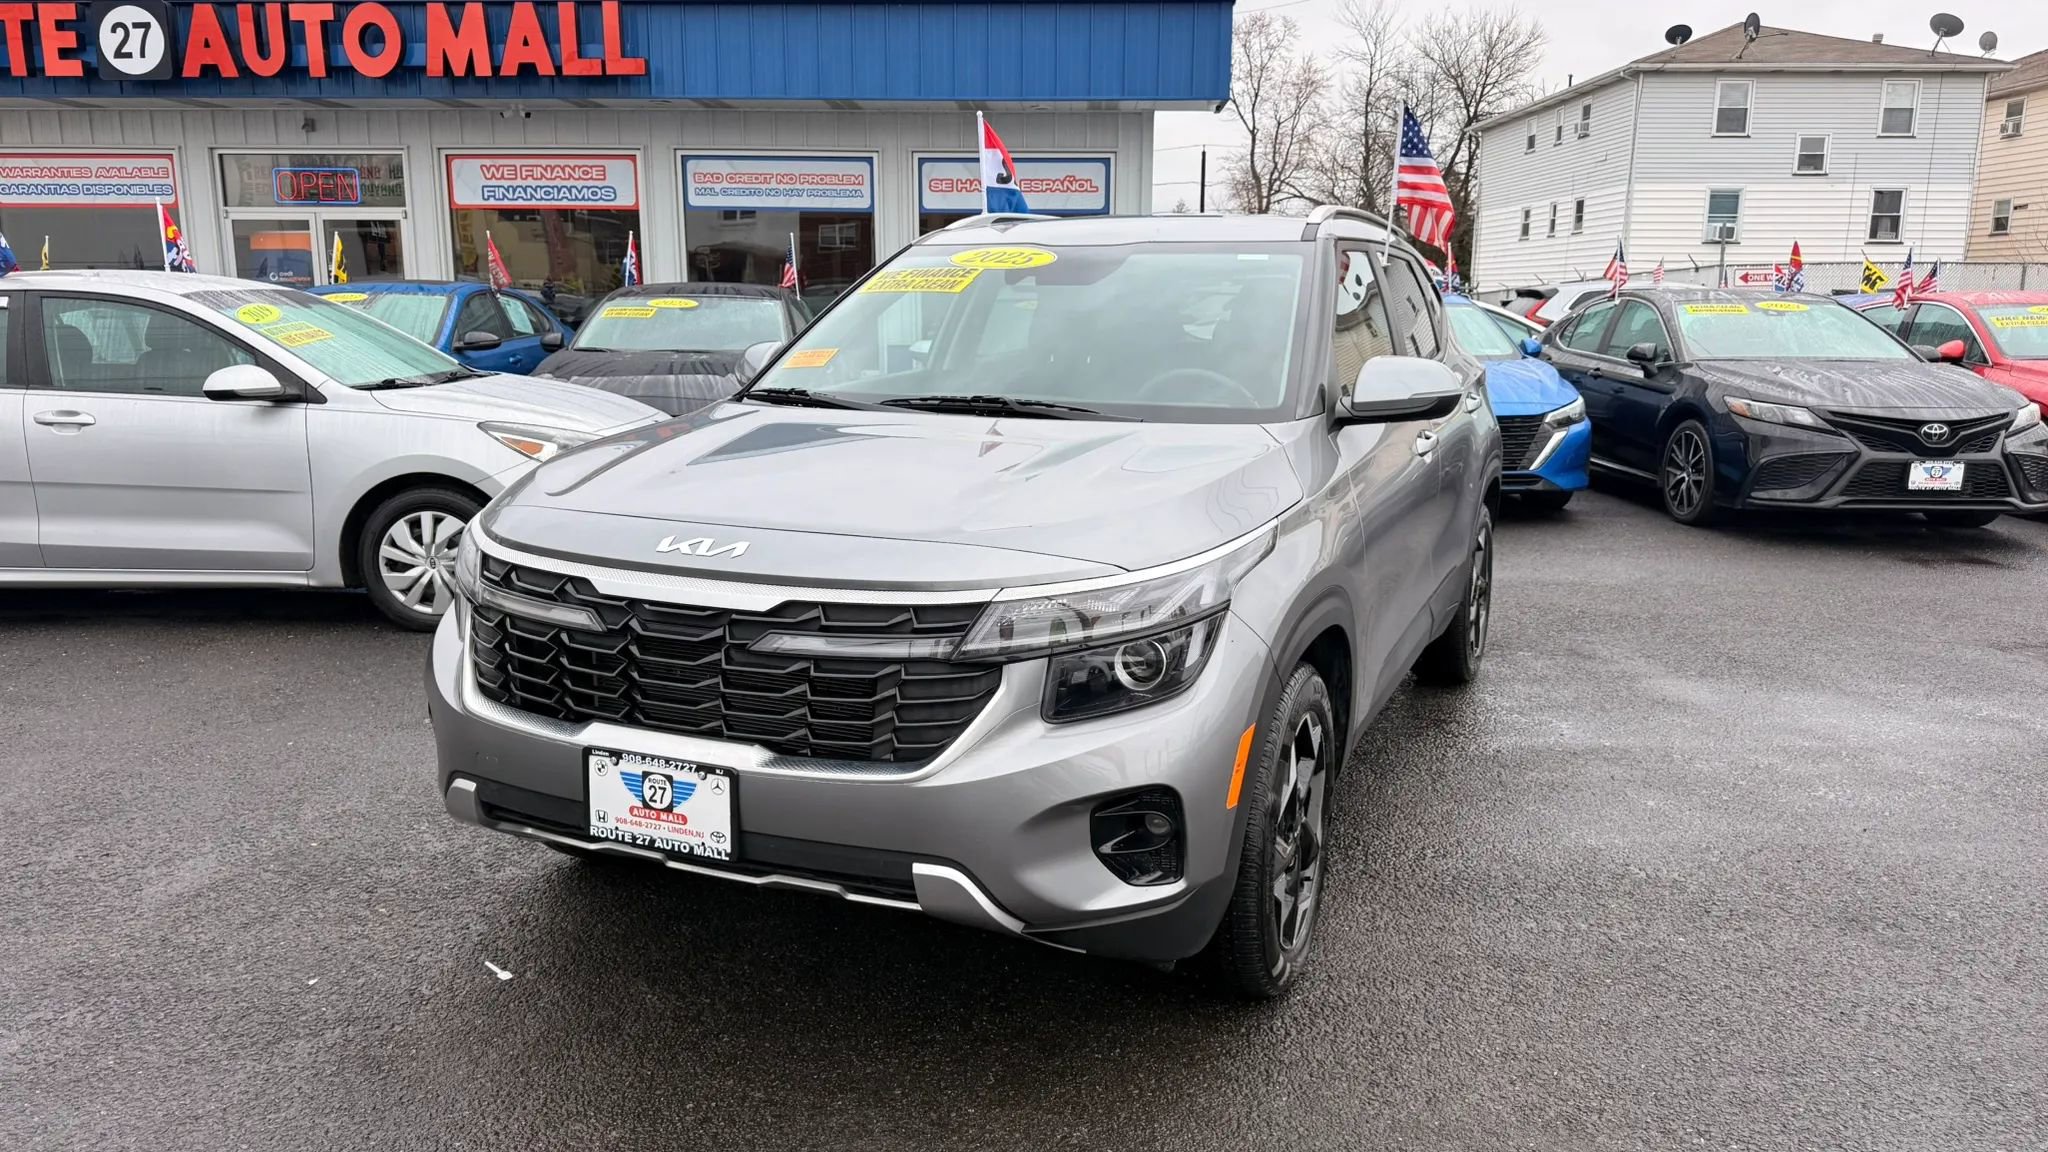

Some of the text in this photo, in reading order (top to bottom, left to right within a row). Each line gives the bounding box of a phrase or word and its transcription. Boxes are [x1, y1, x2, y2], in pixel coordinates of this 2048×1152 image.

[110, 21, 151, 59] 27
[182, 2, 401, 77] AUTO
[427, 1, 646, 76] MALL
[0, 167, 169, 178] WARRANTIES AVAILABLE
[481, 164, 606, 181] WE FINANCE
[693, 172, 864, 185] BAD CREDIT NO PROBLEM
[0, 184, 173, 195] GARANTIAS DISPONIBLES
[276, 171, 357, 200] OPEN
[929, 178, 953, 192] SE
[1020, 175, 1098, 192] ESPAÑOL
[482, 186, 617, 201] FINANCIAMOS
[694, 187, 864, 198] MAL CREDITO NO HAY PROBLEMA
[960, 250, 1043, 265] 2025
[901, 267, 980, 278] FINANCE
[868, 279, 963, 290] EXTRA CLEAN
[655, 535, 751, 559] KIA
[622, 753, 697, 773] 908-648-2727
[648, 777, 667, 786] ROUTE
[649, 785, 667, 804] 27
[632, 807, 685, 824] AUTO MALL
[615, 816, 705, 839] 908-648-2727 LINDEN,NJ
[590, 825, 730, 861] ROUTE 27 AUTO MALL
